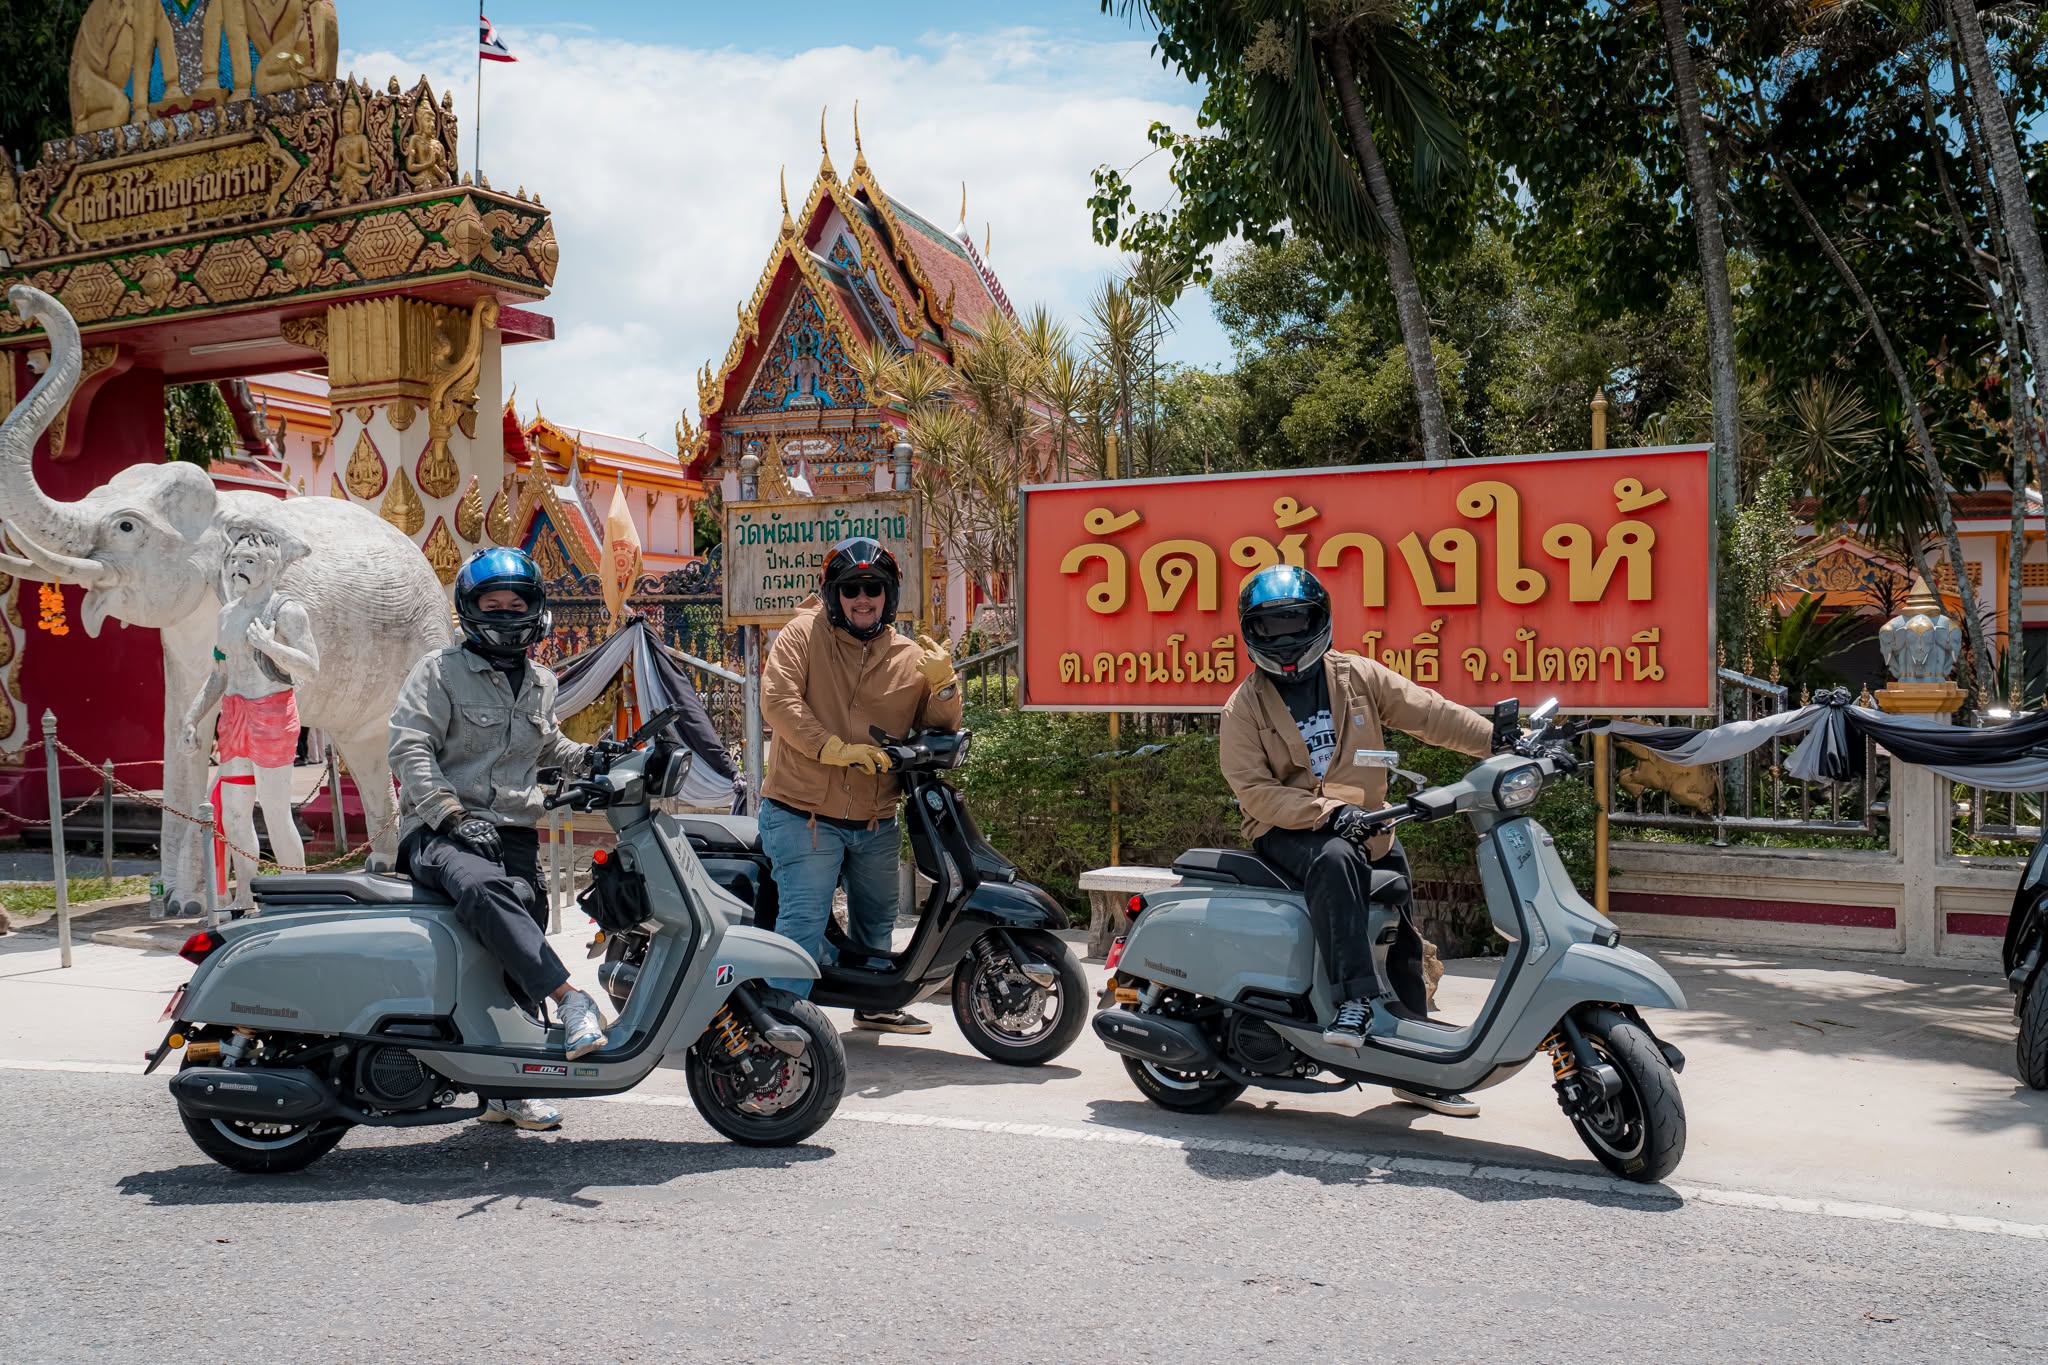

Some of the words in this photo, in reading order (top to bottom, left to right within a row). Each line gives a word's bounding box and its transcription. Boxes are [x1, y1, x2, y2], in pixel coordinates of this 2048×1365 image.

[735, 509, 905, 546] วัดพัฒนาตัวอย่าง
[766, 547, 824, 570] ปีพ.ศ.๒
[755, 594, 804, 610] กระทรว
[1058, 633, 1236, 684] ต.ควนโนรี
[1343, 618, 1444, 682] โพธิ์
[1460, 627, 1665, 682] จ.ปัตตานี
